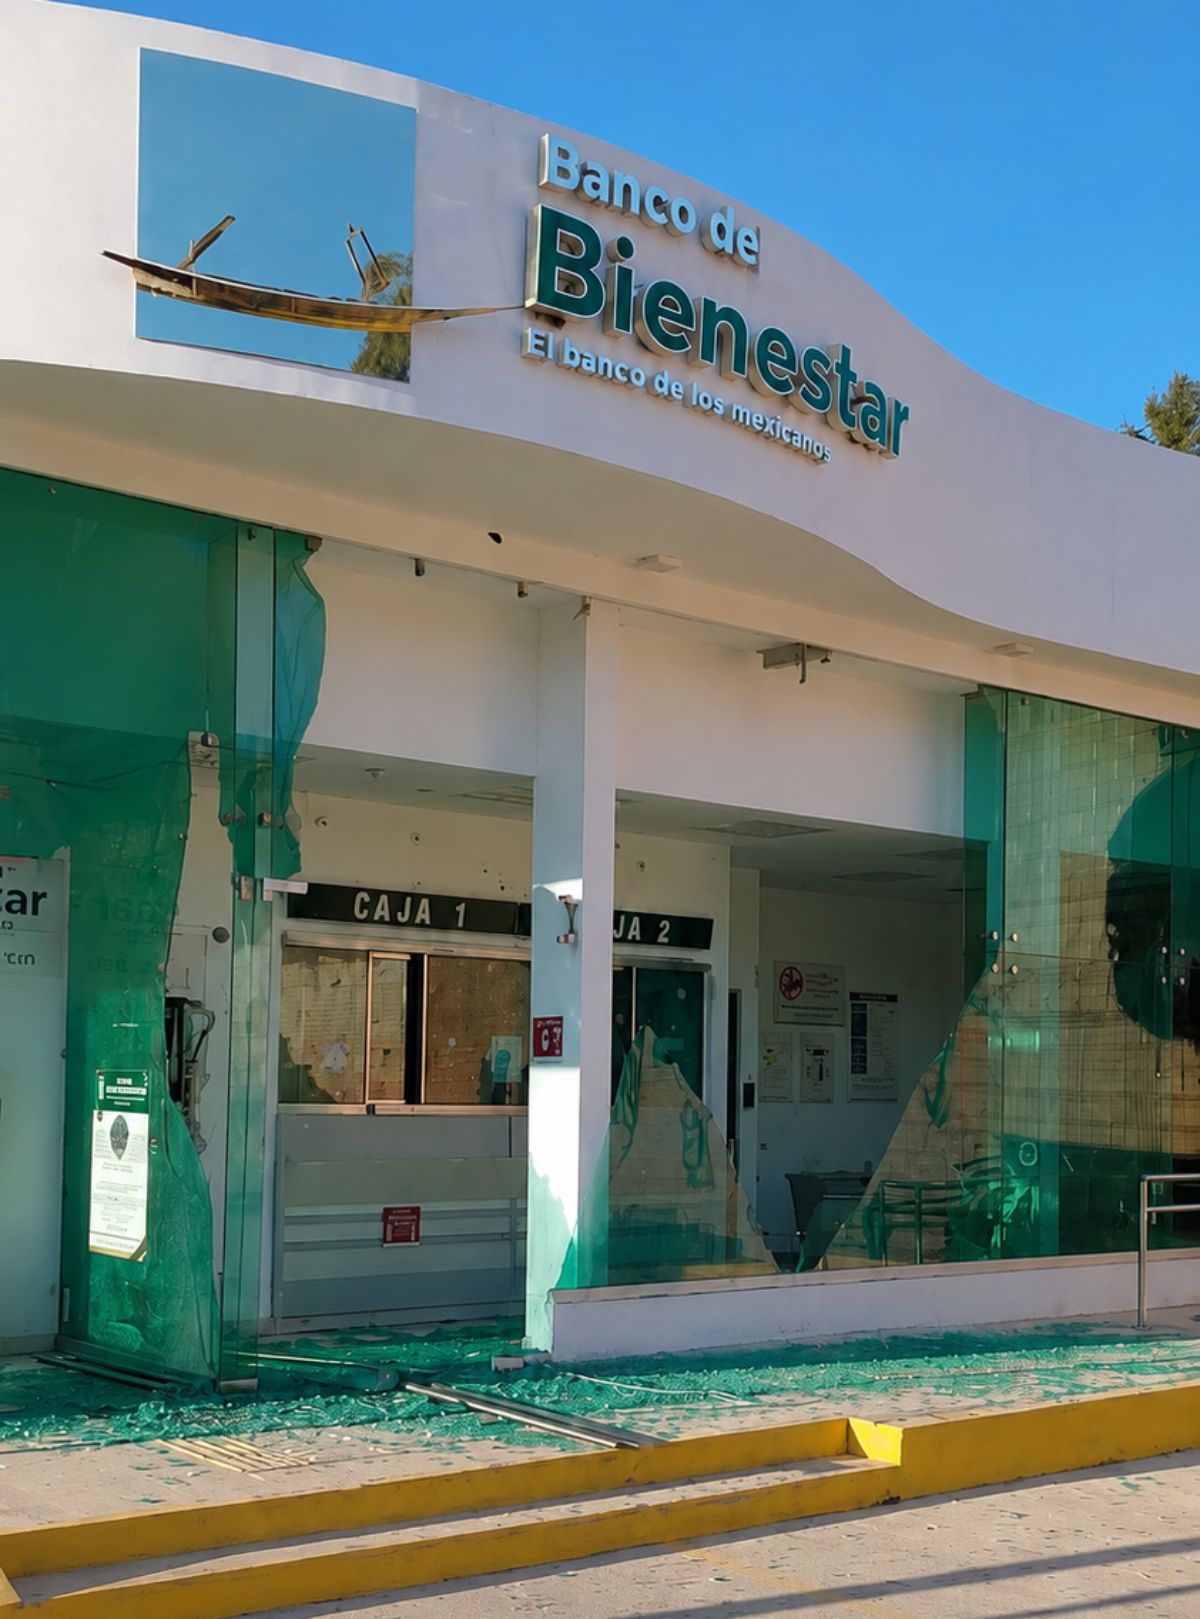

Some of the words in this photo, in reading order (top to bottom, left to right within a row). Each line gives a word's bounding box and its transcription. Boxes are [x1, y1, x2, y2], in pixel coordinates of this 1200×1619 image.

[539, 133, 698, 237] Banco
[702, 206, 760, 272] de
[522, 327, 554, 362] El
[559, 337, 646, 390] banco
[652, 370, 684, 401] de
[686, 382, 725, 416] los
[727, 402, 832, 467] mexicanos
[525, 203, 910, 459] Bienestar
[354, 891, 432, 926] CAJA
[455, 902, 467, 928] 1
[613, 915, 642, 941] JA
[656, 920, 671, 943] 2
